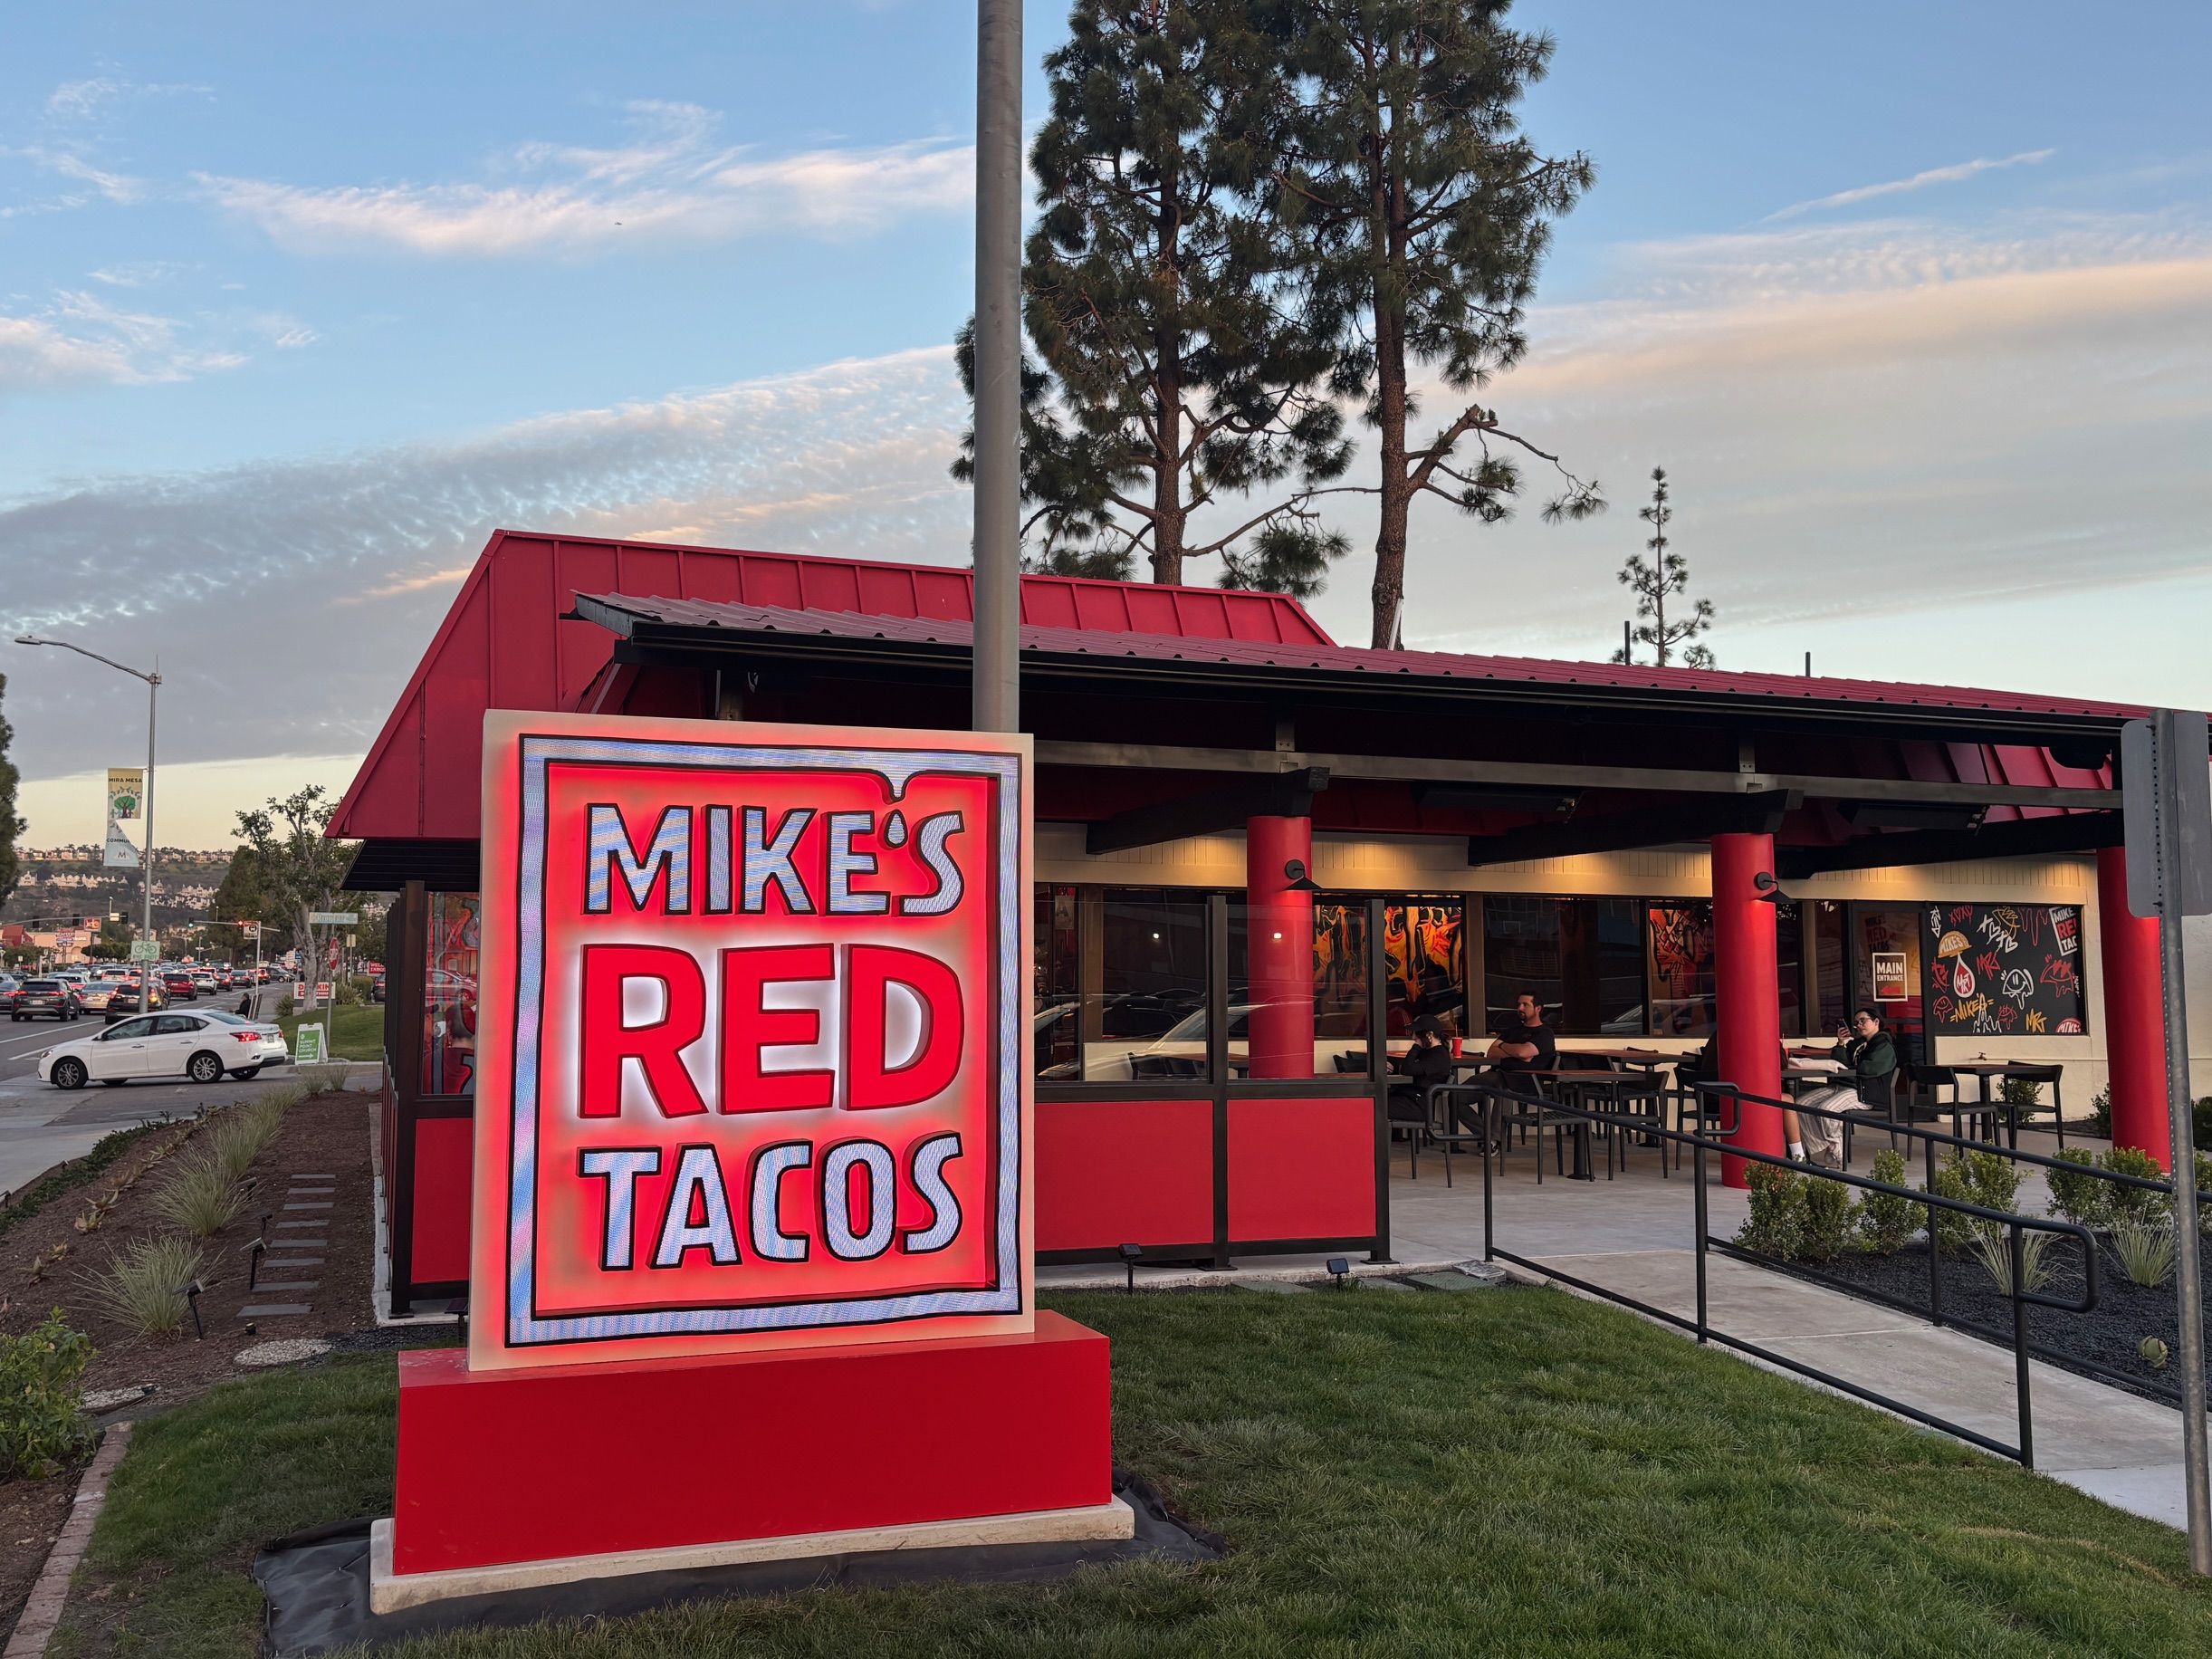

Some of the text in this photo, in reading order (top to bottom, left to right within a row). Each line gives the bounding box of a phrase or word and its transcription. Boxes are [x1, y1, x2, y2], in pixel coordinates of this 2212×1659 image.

[582, 802, 965, 916] MIKE'S
[577, 943, 965, 1119] RED
[1876, 962, 1903, 974] MAIN
[577, 1131, 964, 1272] TACOS
